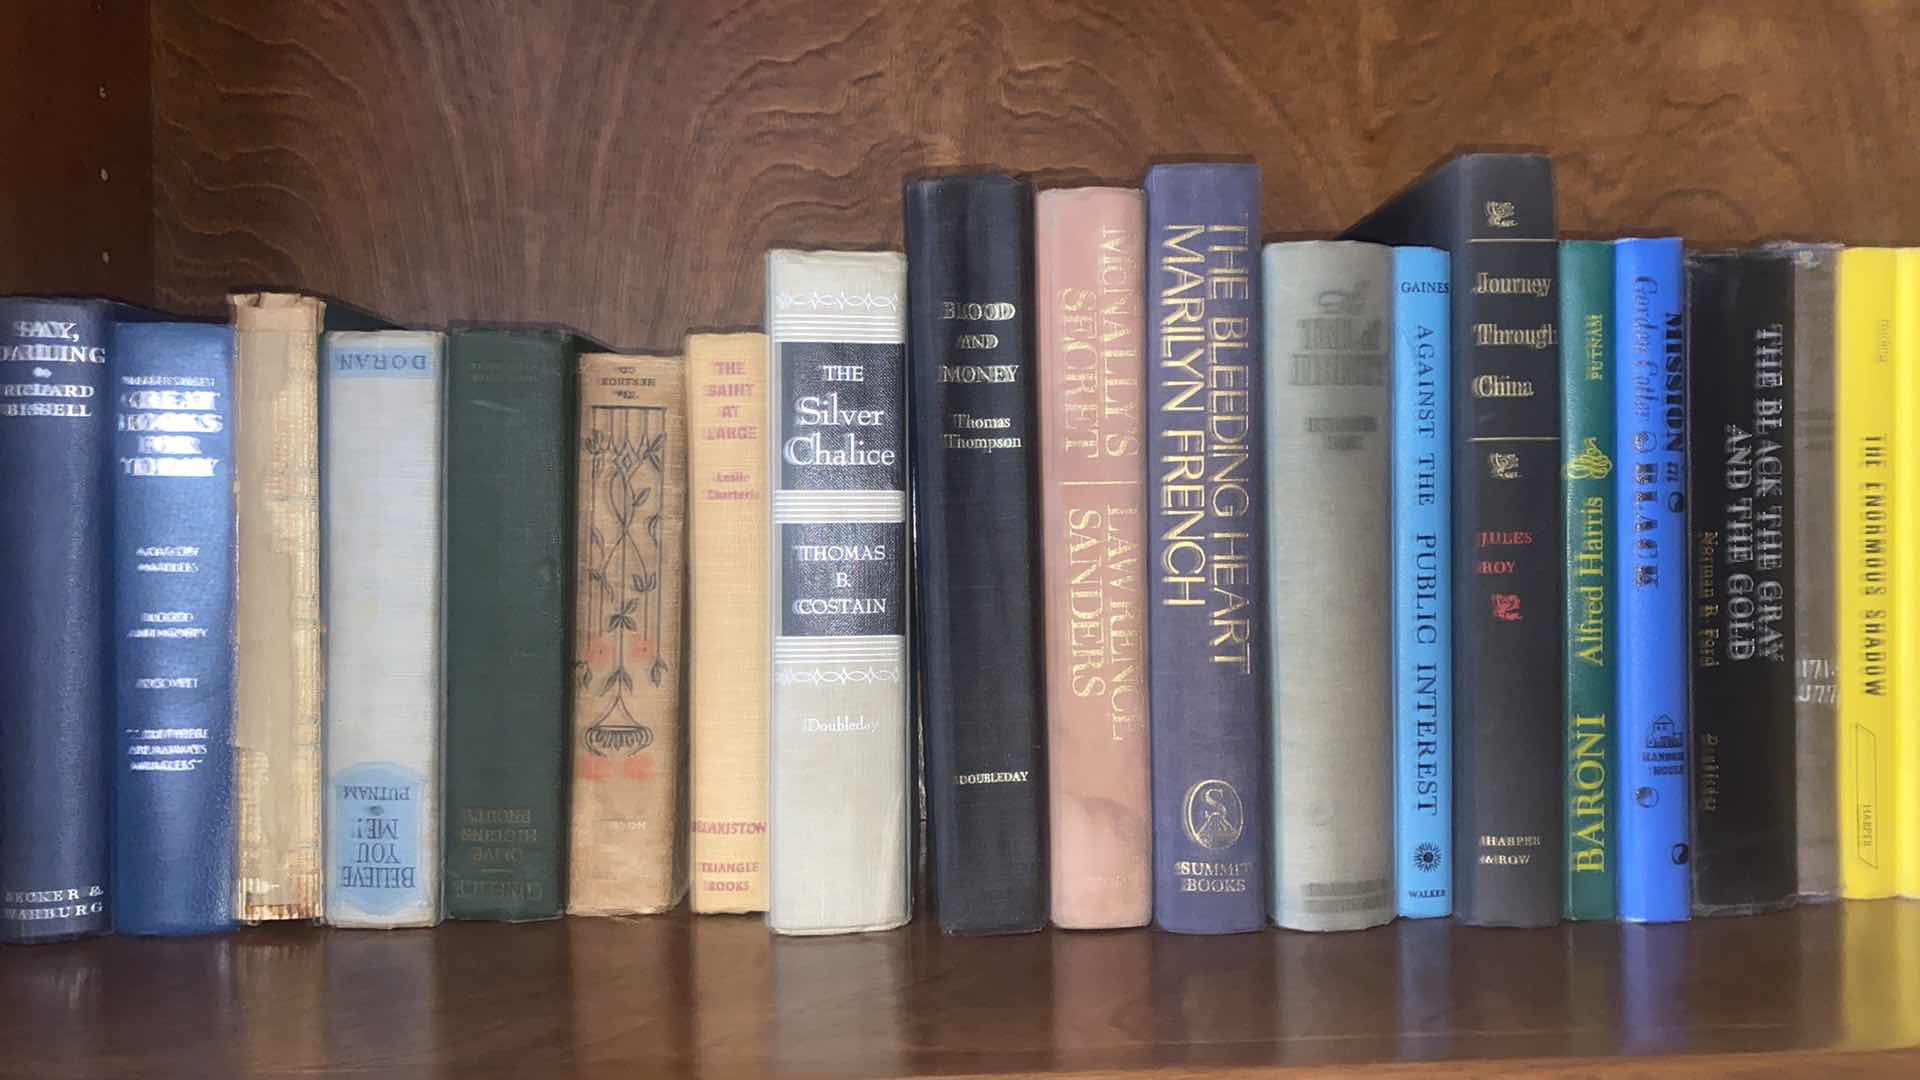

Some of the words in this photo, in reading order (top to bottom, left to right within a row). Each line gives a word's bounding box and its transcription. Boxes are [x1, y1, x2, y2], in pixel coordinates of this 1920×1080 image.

[1207, 212, 1250, 300] THE
[1400, 281, 1450, 295] GAINES
[1473, 272, 1553, 297] Journey
[941, 301, 1017, 320] BLOOD
[1160, 224, 1206, 412] MARILYN
[13, 321, 80, 342] SAY,
[958, 333, 1000, 349] AND
[1584, 313, 1603, 380] PUTNAM
[1754, 324, 1783, 388] THE
[336, 354, 427, 371] DORAN
[713, 361, 746, 376] THE
[821, 365, 864, 383] THE
[938, 364, 1020, 383] MONEY
[1060, 287, 1099, 459] SECRET
[3, 384, 95, 397] RICHARD
[704, 384, 755, 398] SAINT
[1415, 325, 1436, 440] AGAINST
[1473, 374, 1535, 398] China
[1664, 312, 1684, 452] MISSION
[5, 403, 92, 417] BISSELL
[719, 405, 740, 419] AT
[795, 392, 885, 426] Silver
[1207, 317, 1251, 517] BLEEDING
[952, 413, 1011, 430] Thomas
[703, 427, 758, 440] LARGE
[942, 433, 1022, 453] Thompson
[784, 432, 896, 466] Chalice
[1723, 424, 1753, 490] AND
[1754, 398, 1784, 498] BLACK
[1863, 436, 1888, 468] THE
[1417, 452, 1437, 506] THE
[1160, 430, 1207, 605] FRENCH
[1633, 462, 1659, 589] BLACK
[1476, 531, 1534, 547] JULES
[1576, 496, 1604, 577] Harris
[1726, 497, 1754, 564] THE
[1756, 505, 1783, 571] THE
[1863, 481, 1888, 597] ENORMOUS
[795, 545, 887, 562] THOMAS
[1474, 560, 1516, 575] ROY
[1415, 533, 1438, 645] PUBLIC
[793, 598, 888, 615] COSTAIN
[1068, 508, 1106, 697] SANDERS
[1209, 531, 1252, 675] HEART
[1104, 503, 1140, 741] LAWRENCE
[1576, 585, 1604, 666] Alfred
[1727, 572, 1755, 662] GOLD
[1757, 580, 1785, 662] GRAY
[1863, 608, 1888, 698] SHADOW
[804, 715, 880, 733] Doubleday
[1416, 663, 1438, 816] INTEREST
[957, 771, 1029, 785] DOUBLEDAY
[343, 785, 410, 801] PUTNAM
[1574, 713, 1606, 873] BARONI
[355, 818, 399, 840] ME!
[355, 843, 401, 864] YOU
[1479, 836, 1542, 848] HARPER
[340, 865, 416, 888] BELIEVE
[701, 862, 760, 874] TRIANGLE
[1175, 861, 1251, 876] SUMMIT
[89, 885, 104, 897] &
[703, 881, 751, 892] BOOKS
[1183, 877, 1247, 893] BOOKS
[1408, 888, 1447, 900] WALKER
